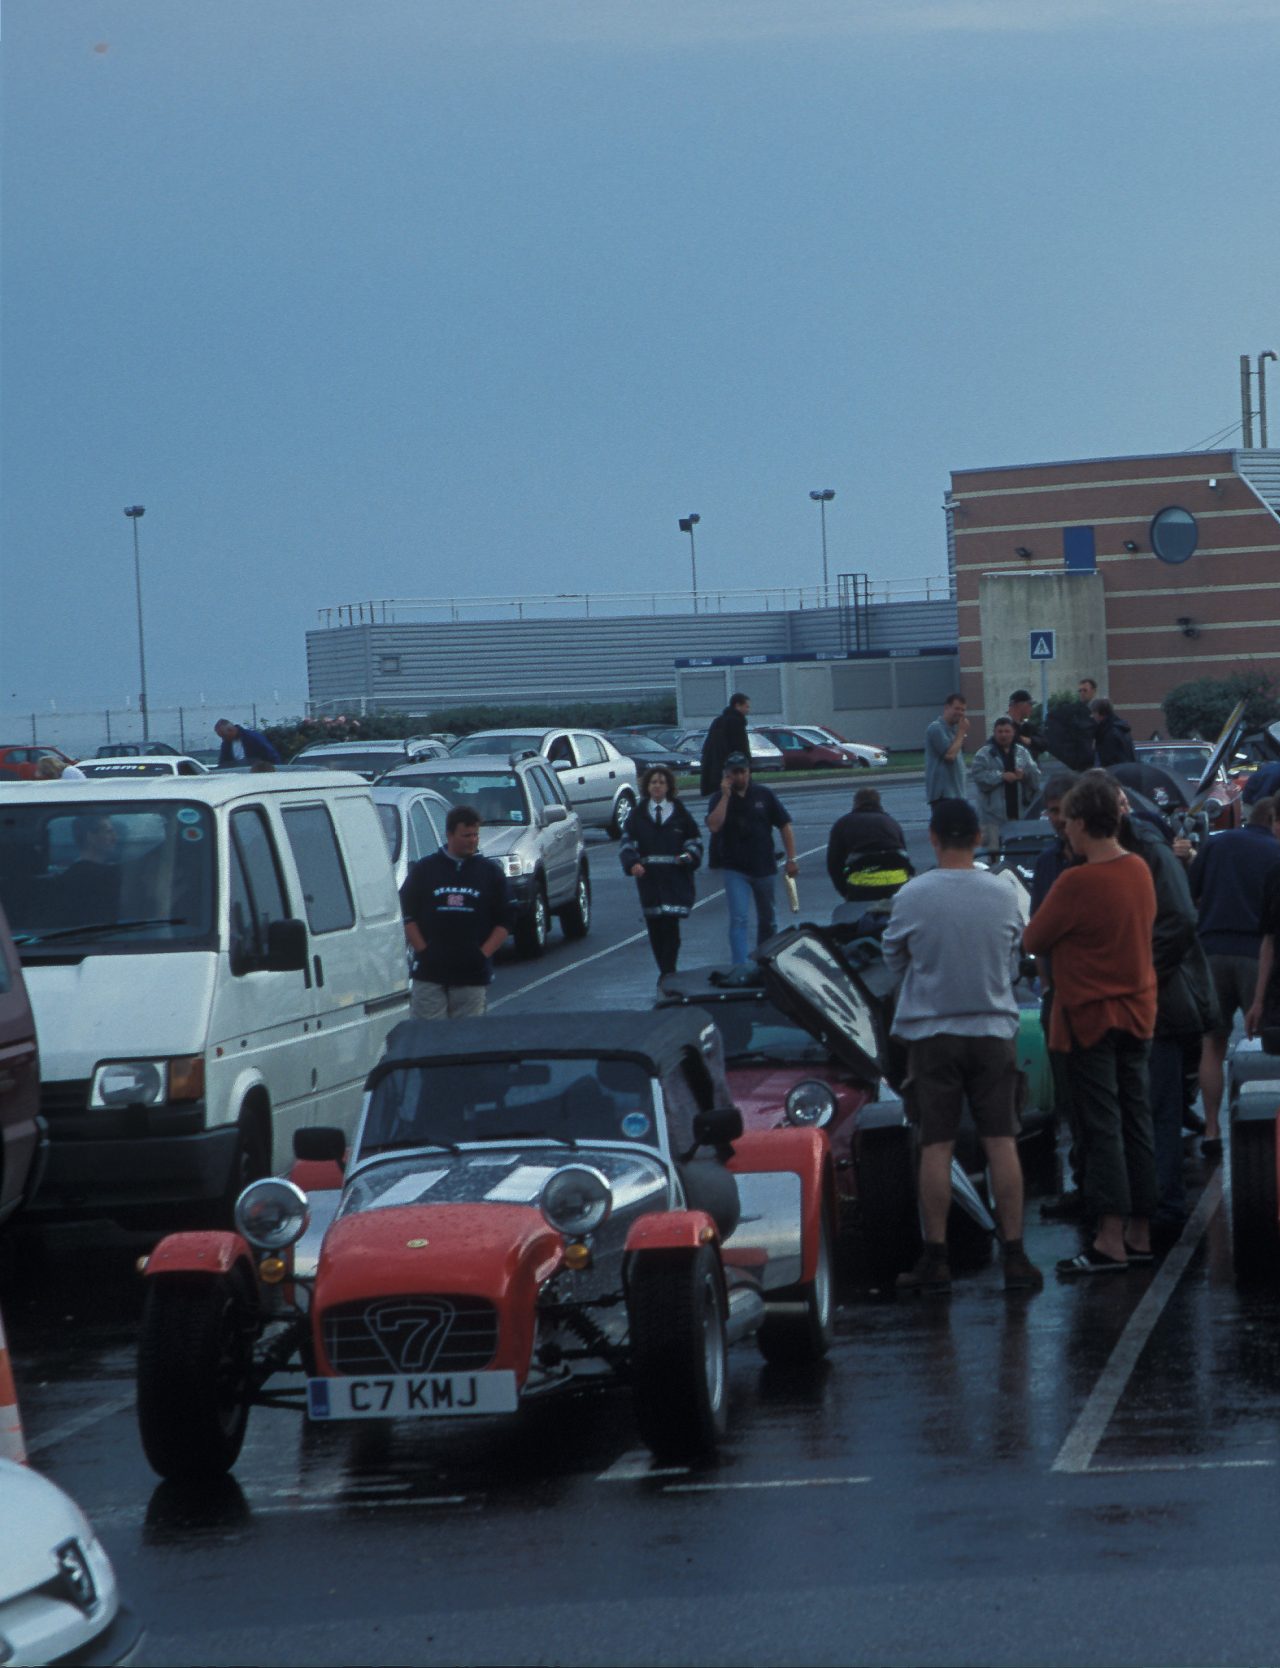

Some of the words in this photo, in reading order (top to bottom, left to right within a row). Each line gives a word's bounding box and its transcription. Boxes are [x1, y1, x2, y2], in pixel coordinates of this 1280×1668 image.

[376, 1306, 445, 1367] 7
[351, 1381, 395, 1411] C7
[407, 1377, 478, 1410] KMJ
